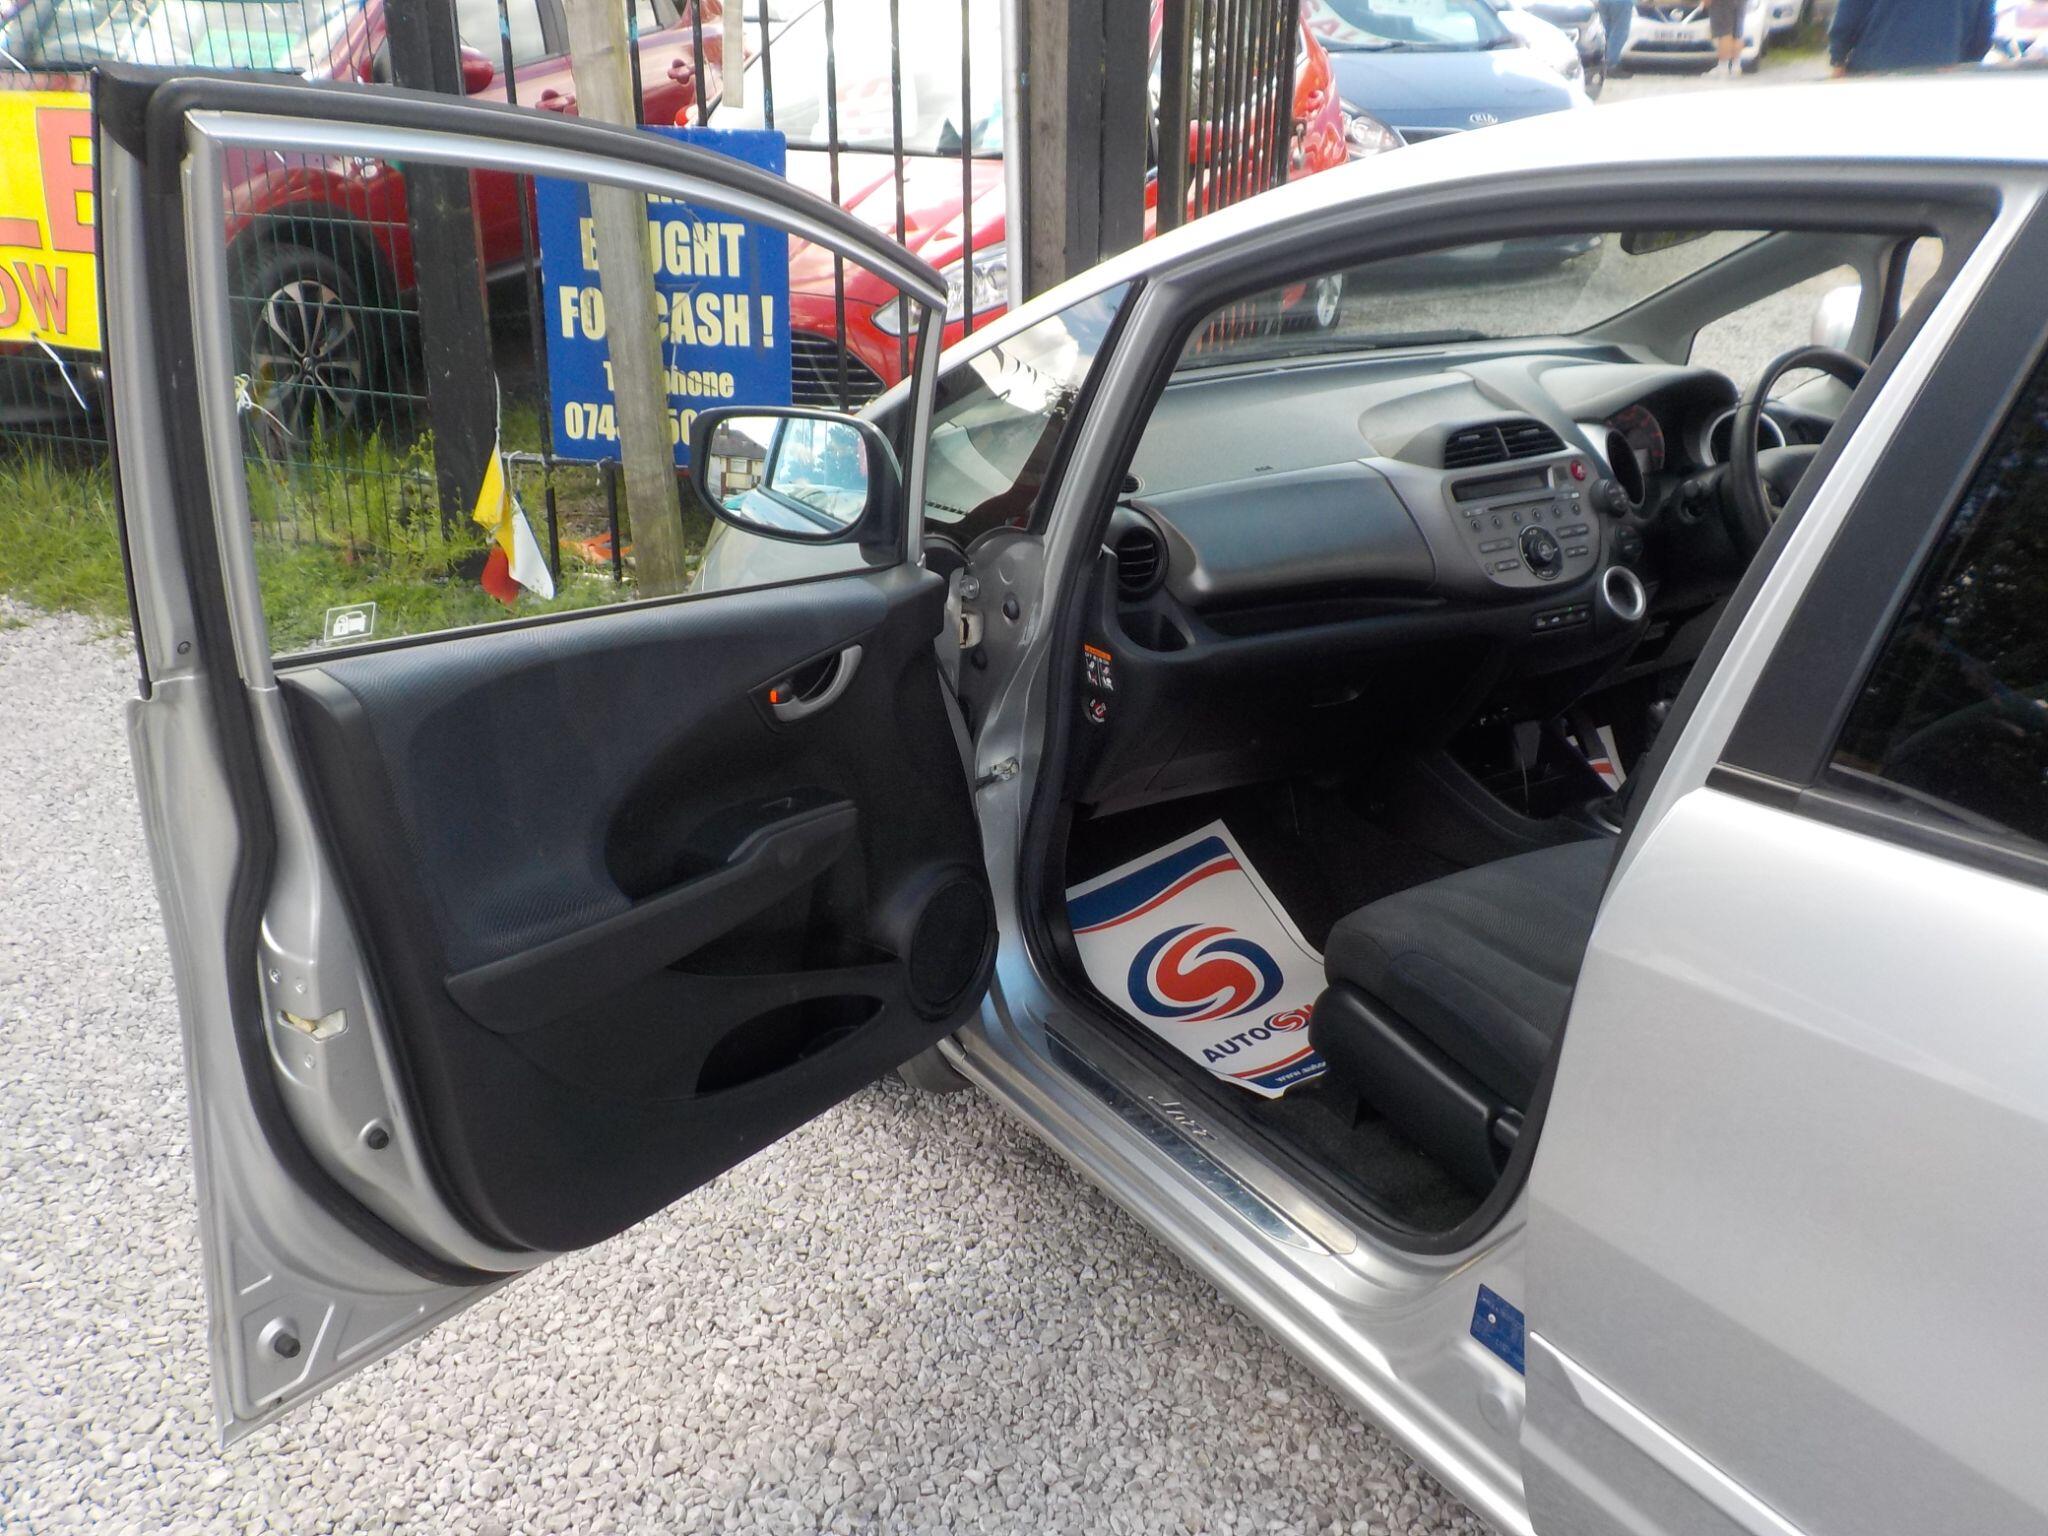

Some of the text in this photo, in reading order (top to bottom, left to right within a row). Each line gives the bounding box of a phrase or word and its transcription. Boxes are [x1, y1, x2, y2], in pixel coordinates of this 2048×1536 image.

[0, 106, 95, 253] E
[579, 217, 745, 278] BGHT
[559, 285, 606, 341] FO
[603, 360, 735, 398] Thone
